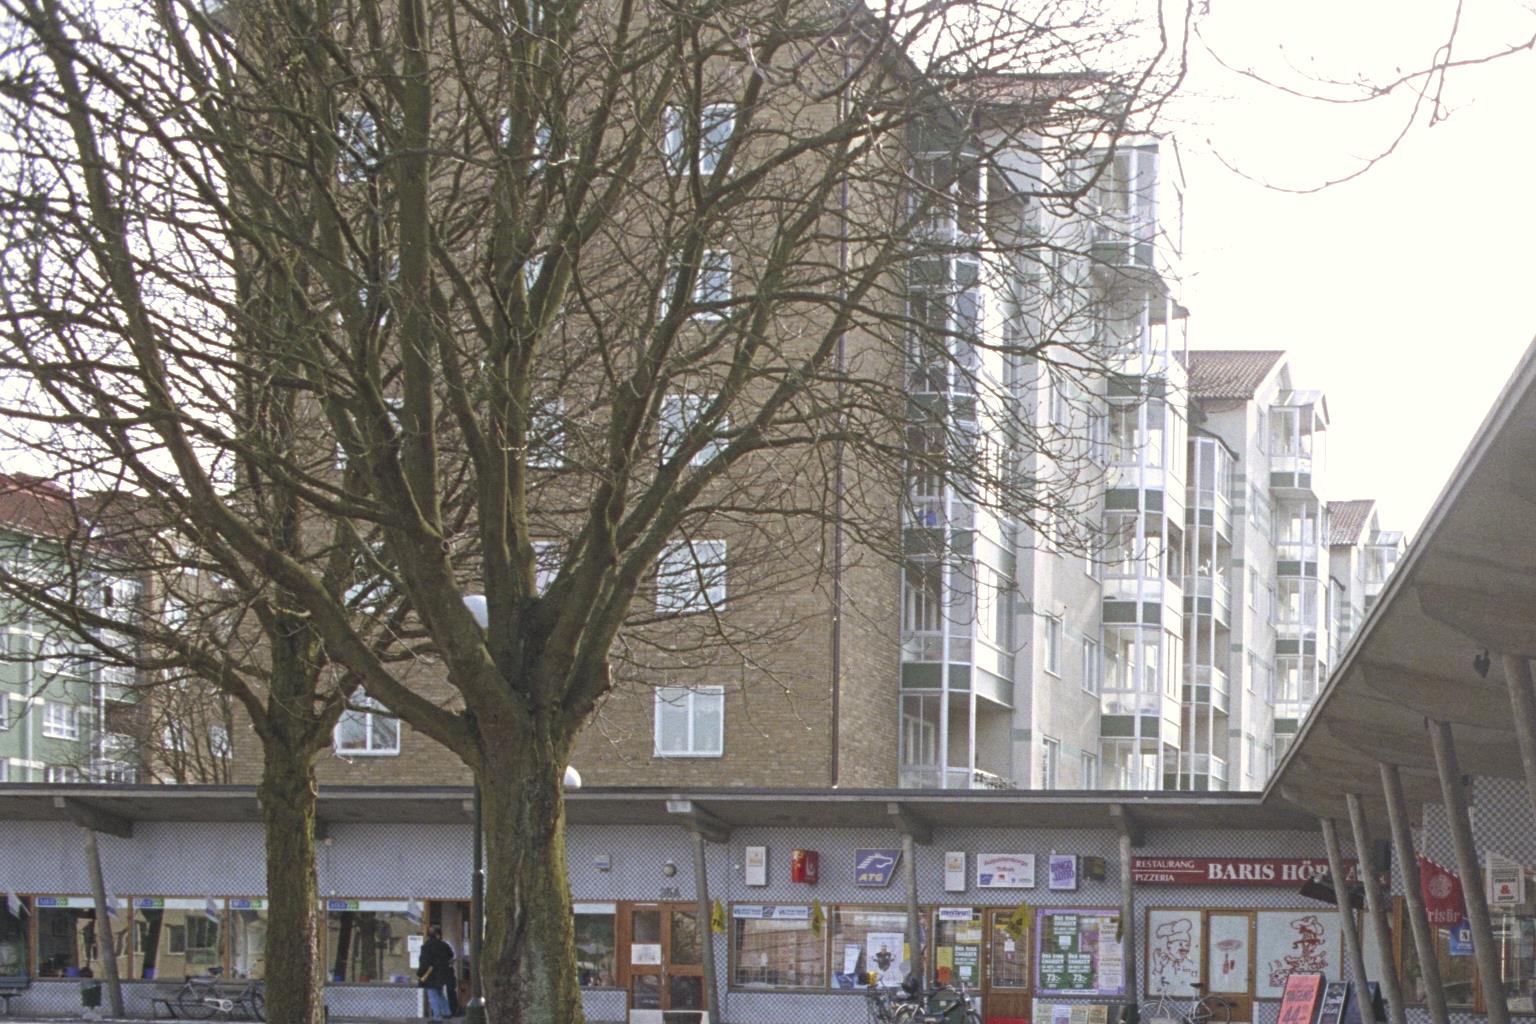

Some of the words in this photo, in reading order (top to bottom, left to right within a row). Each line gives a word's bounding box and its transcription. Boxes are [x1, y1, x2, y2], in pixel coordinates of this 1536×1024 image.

[1136, 860, 1195, 869] RESTAURANG
[858, 872, 884, 882] ATG
[1208, 863, 1275, 881] BARIS
[1136, 874, 1175, 882] PIZZERIA
[1427, 908, 1459, 923] risör
